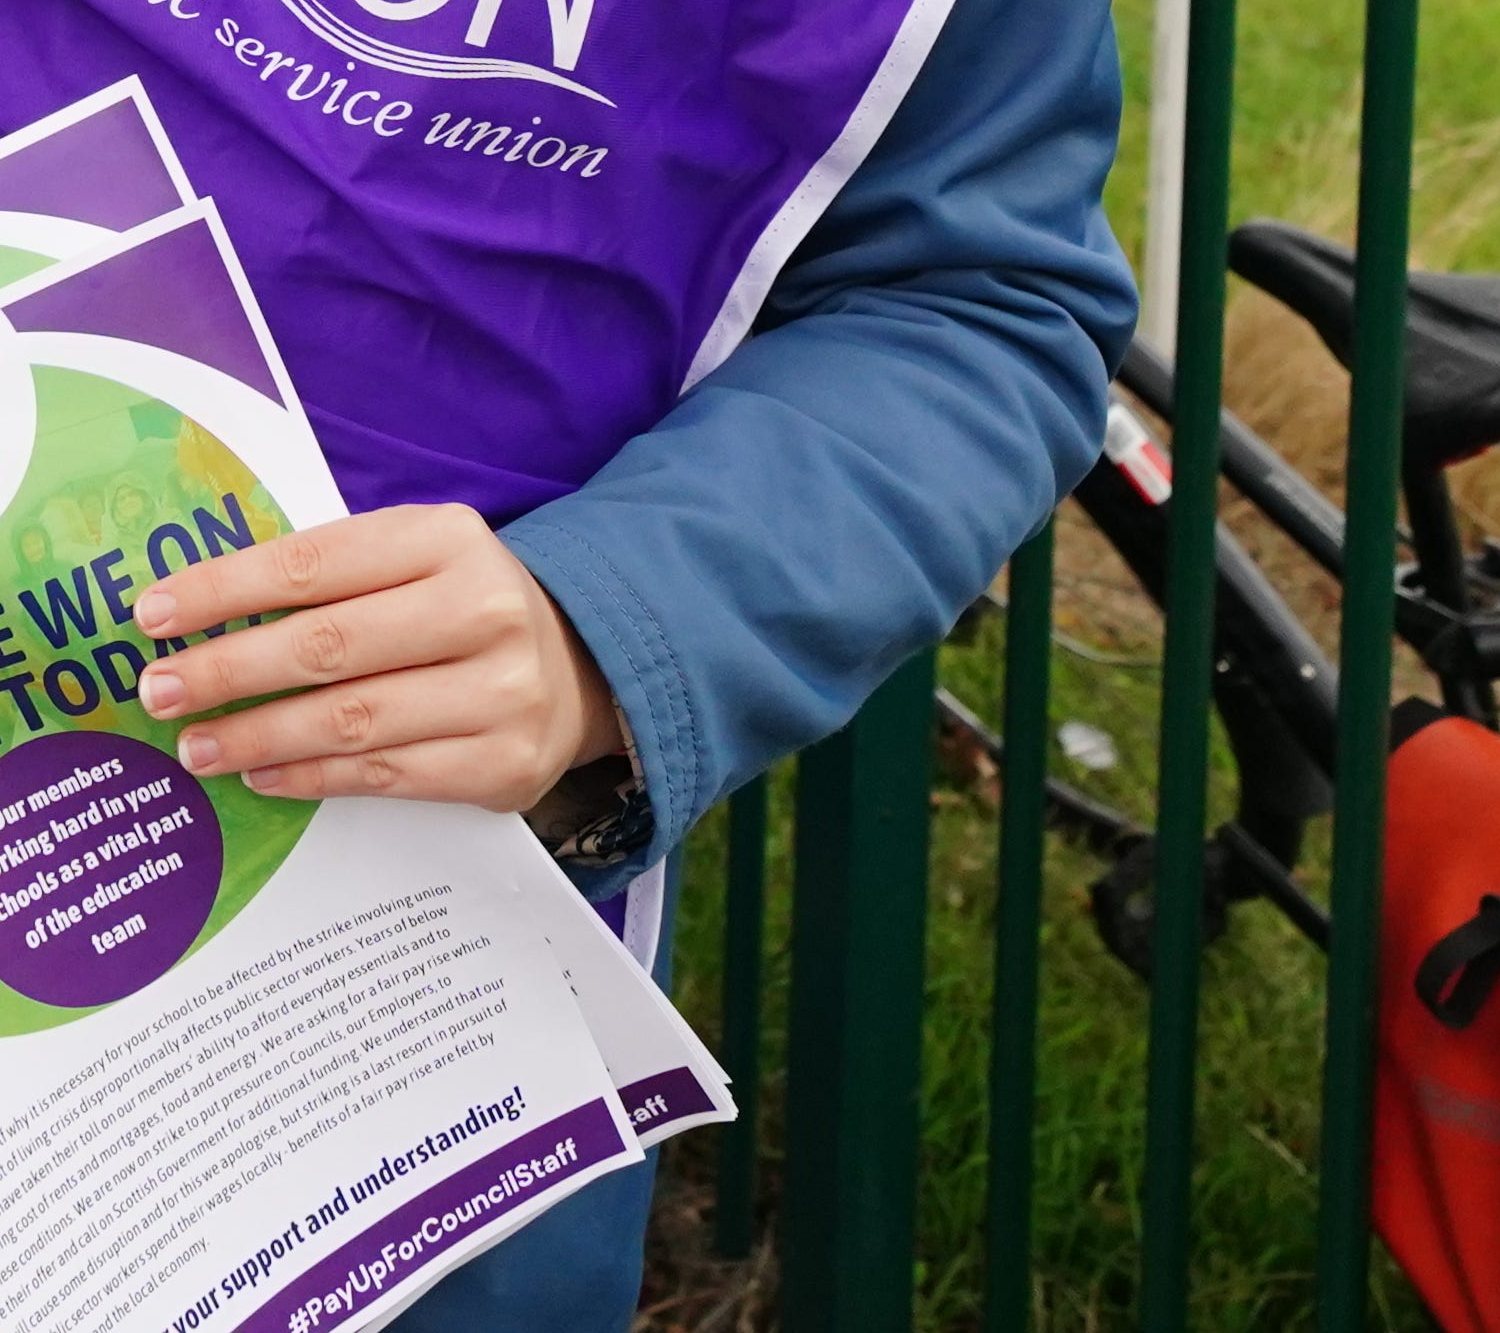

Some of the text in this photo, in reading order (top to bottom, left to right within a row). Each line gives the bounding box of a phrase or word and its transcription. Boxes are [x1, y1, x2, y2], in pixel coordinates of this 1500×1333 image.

[215, 18, 414, 137] service
[424, 112, 610, 180] union
[20, 550, 133, 647] WE
[148, 494, 253, 579] ON
[27, 759, 123, 812] members
[50, 801, 103, 842] hard
[100, 798, 125, 818] in
[124, 777, 171, 813] your
[59, 859, 83, 883] as
[84, 852, 99, 869] a
[97, 823, 148, 861] vital
[147, 806, 193, 844] part
[26, 853, 183, 948] of the education
[92, 914, 146, 954] team
[5, 1113, 30, 1138] why
[29, 1105, 40, 1121] it
[37, 1098, 50, 1113] is
[49, 1057, 106, 1105] necessary
[104, 1044, 123, 1064] for
[123, 1026, 151, 1055] your
[152, 999, 194, 1034] school
[192, 994, 207, 1009] to
[205, 984, 225, 1001] be
[225, 952, 277, 991] affected
[275, 947, 293, 963] by
[292, 937, 316, 955] the
[315, 920, 354, 944] strike
[352, 895, 415, 927] involving
[414, 885, 452, 905] union
[6, 1151, 19, 1172] of
[16, 1130, 52, 1162] living
[50, 1107, 80, 1137] crisis
[79, 1038, 181, 1114] disproportionally
[180, 1013, 223, 1045] affects
[222, 990, 264, 1024] public
[262, 969, 301, 998] sector
[301, 944, 357, 977] workers.
[353, 926, 394, 950] Years
[393, 916, 408, 934] of
[406, 906, 448, 928] below
[15, 1207, 39, 1233] cost
[37, 1193, 50, 1214] of
[49, 1175, 78, 1205] rents
[77, 1153, 100, 1181] and
[98, 1112, 164, 1164] mortgages,
[161, 1087, 191, 1117] food
[190, 1071, 215, 1098] and
[260, 1035, 284, 1053] We
[283, 1023, 306, 1042] are
[306, 999, 349, 1029] asking
[346, 989, 366, 1008] for
[367, 986, 378, 998] a
[376, 972, 401, 993] fair
[402, 962, 426, 984] pay
[426, 951, 452, 970] rise
[450, 935, 491, 959] which
[20, 1161, 54, 1194] taken
[51, 1139, 79, 1168] their
[79, 1120, 102, 1146] toll
[100, 1112, 117, 1130] on
[116, 1096, 136, 1119] our
[137, 1053, 193, 1104] members’
[196, 1033, 236, 1065] ability
[235, 1026, 250, 1041] to
[250, 1000, 290, 1032] afford
[290, 973, 347, 1010] everyday
[347, 943, 410, 981] essentials
[410, 929, 438, 952] and
[435, 927, 451, 941] to
[18, 1213, 76, 1266] conditions.
[72, 1196, 94, 1217] We
[92, 1180, 113, 1202] are
[112, 1160, 136, 1186] now
[136, 1149, 153, 1167] on
[152, 1125, 186, 1156] strike
[185, 1116, 200, 1131] to
[199, 1100, 222, 1126] put
[220, 1069, 274, 1112] pressure
[273, 1059, 290, 1076] on
[289, 1029, 347, 1065] Councils,
[346, 1015, 367, 1035] our
[367, 983, 438, 1023] Employers,
[437, 976, 452, 990] to
[222, 1222, 304, 1298] support
[306, 1187, 349, 1234] and
[350, 1086, 525, 1203] understanding!
[289, 1138, 577, 1333] #PayUpForCouncilStaff
